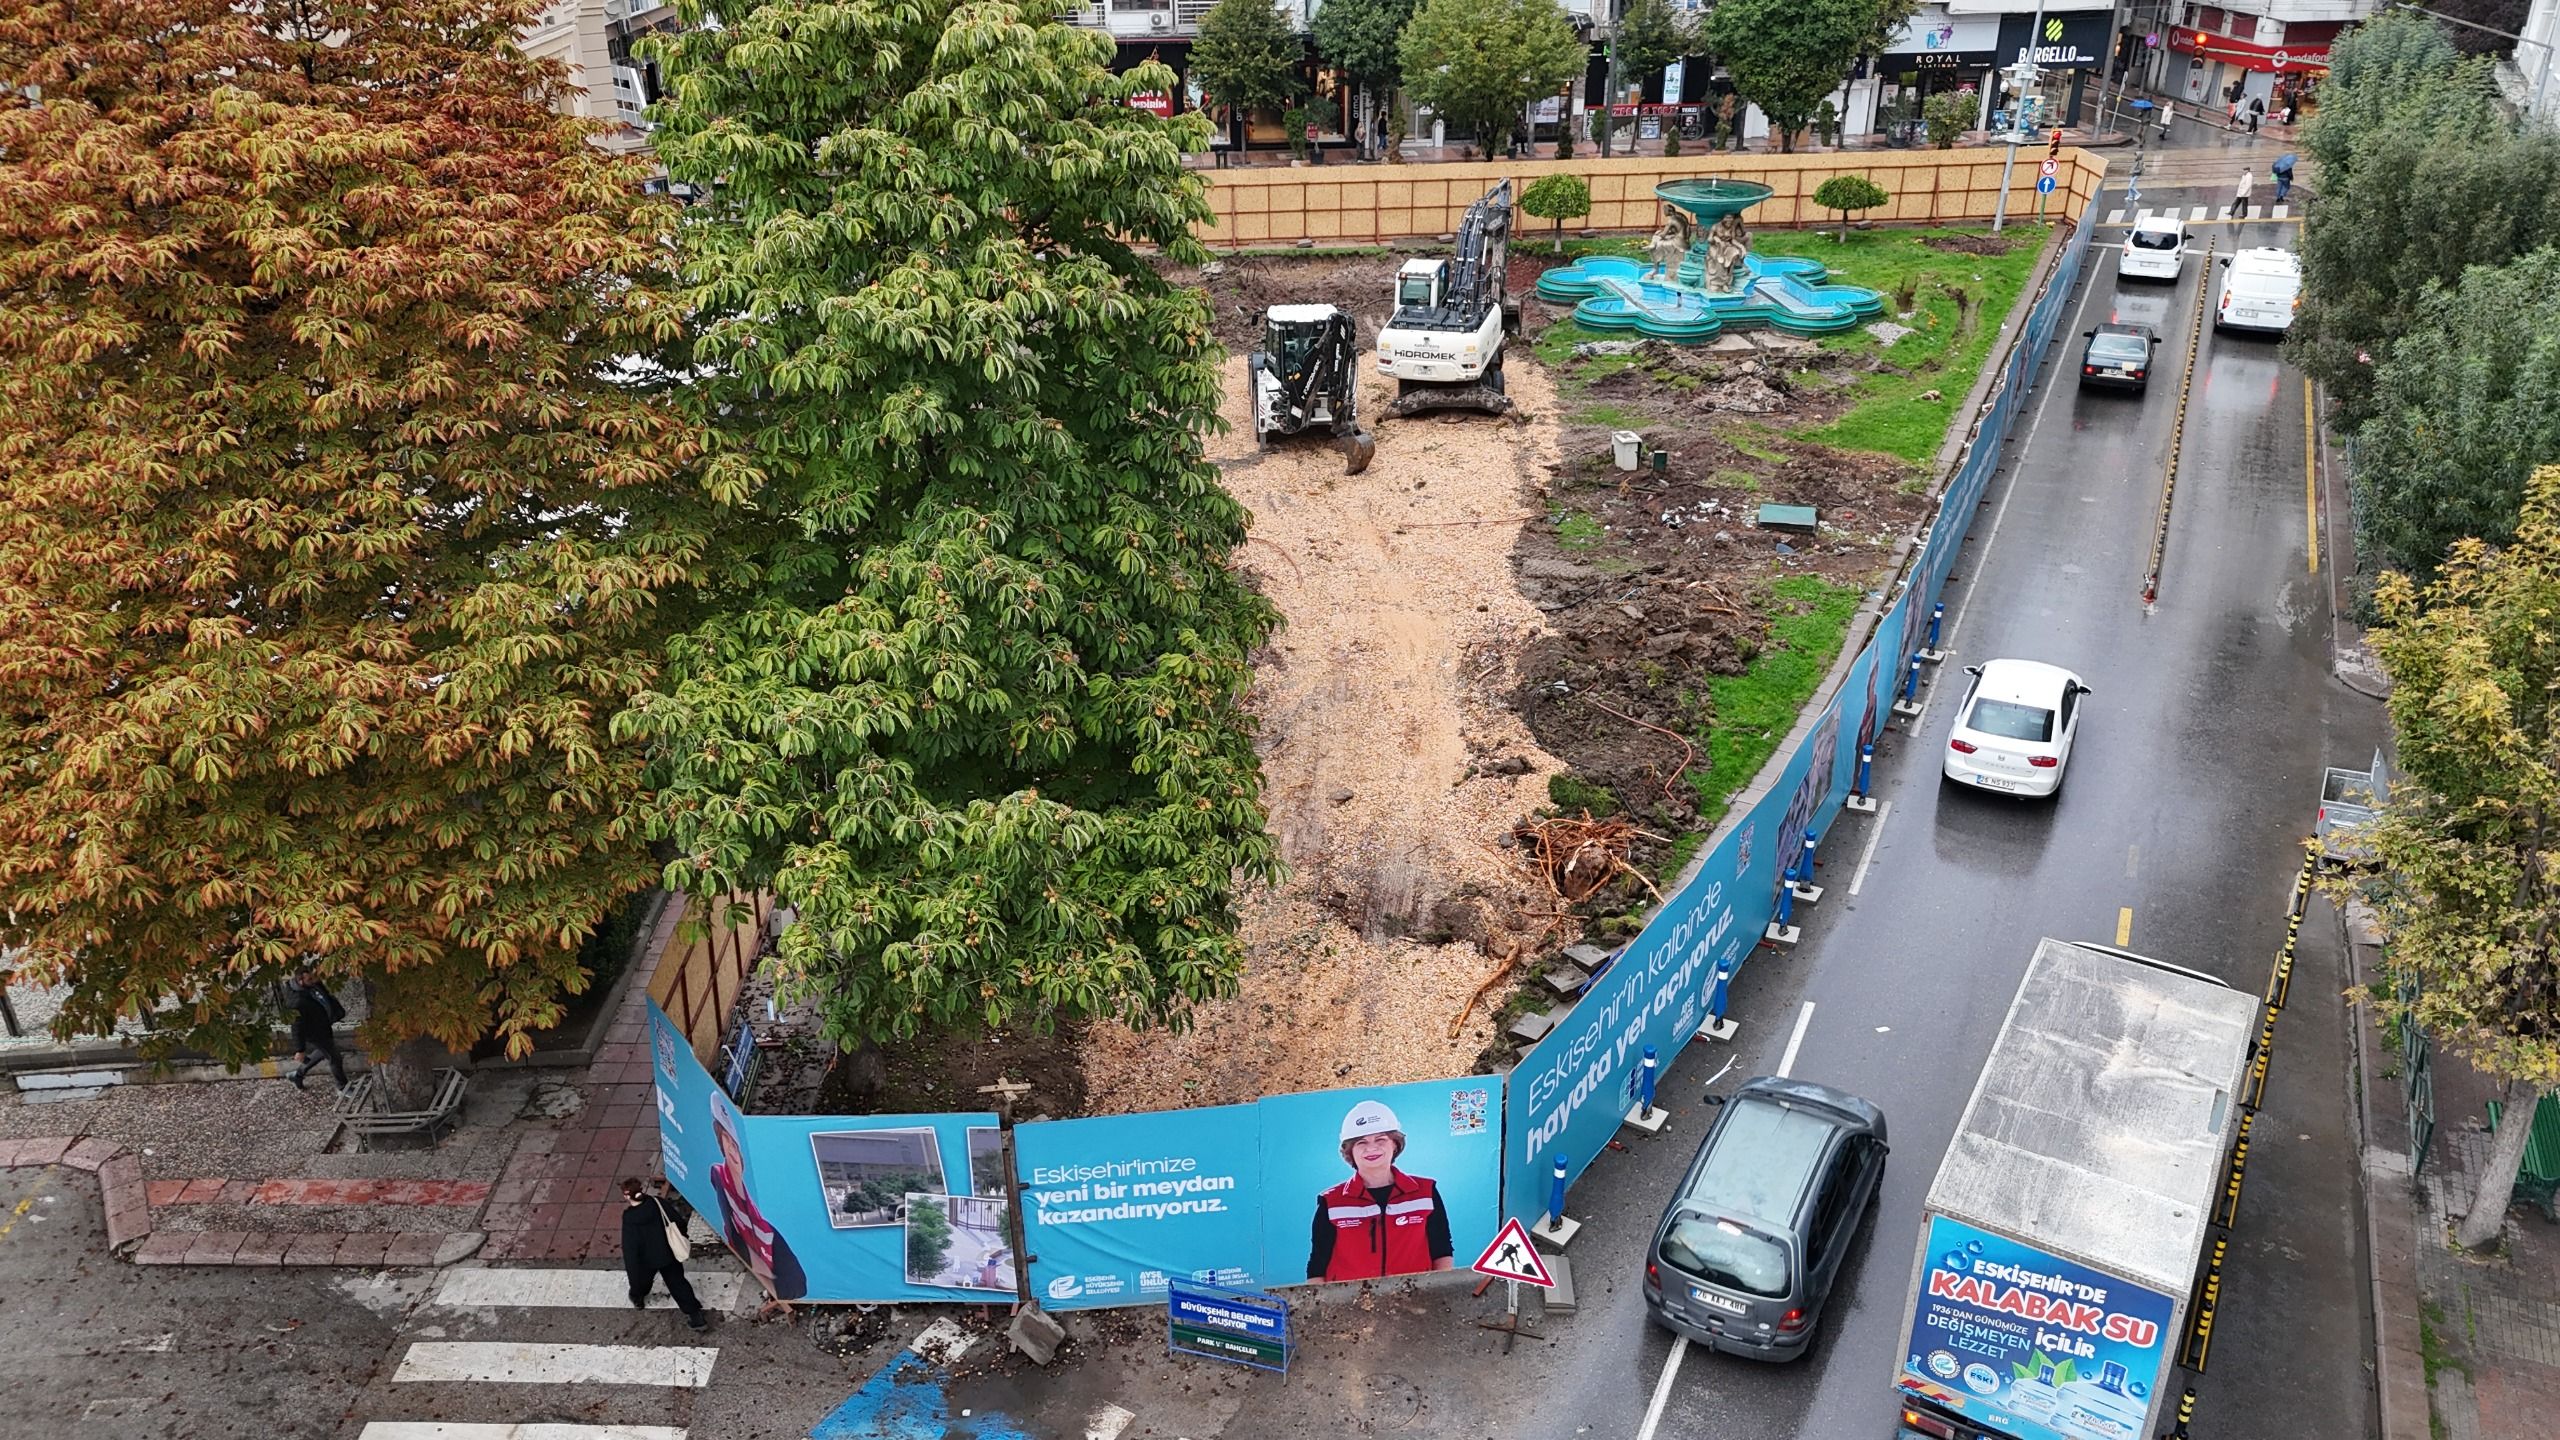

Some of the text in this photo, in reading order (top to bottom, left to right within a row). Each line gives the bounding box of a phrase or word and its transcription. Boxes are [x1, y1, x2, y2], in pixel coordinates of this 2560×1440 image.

[1915, 54, 1961, 64] ROYAL
[1529, 880, 1722, 1118] Eskişehir'in kalbinde
[1526, 904, 1734, 1164] hayata yer açıyoruz.
[1034, 1155, 1196, 1184] Eskişehir'imize
[1035, 1176, 1234, 1209] yeni bir meydan
[1038, 1199, 1228, 1225] kazandırıyoruz.
[1180, 1301, 1275, 1328] BÜYÜKŞEHİR BELEDİYESİ
[1207, 1316, 1247, 1331] ÇALIŞIYOR
[1930, 1269, 2157, 1347] KALABAK SU
[1932, 1303, 2029, 1336] 1936'DAN GÜNÜMÜZE
[1196, 1337, 1215, 1347] PARK
[1224, 1342, 1258, 1356] BAHÇELER
[1927, 1313, 2031, 1351] DEĞİŞMEYEN
[1948, 1335, 2008, 1360] LEZZET
[2035, 1327, 2096, 1360] İÇİLİR
